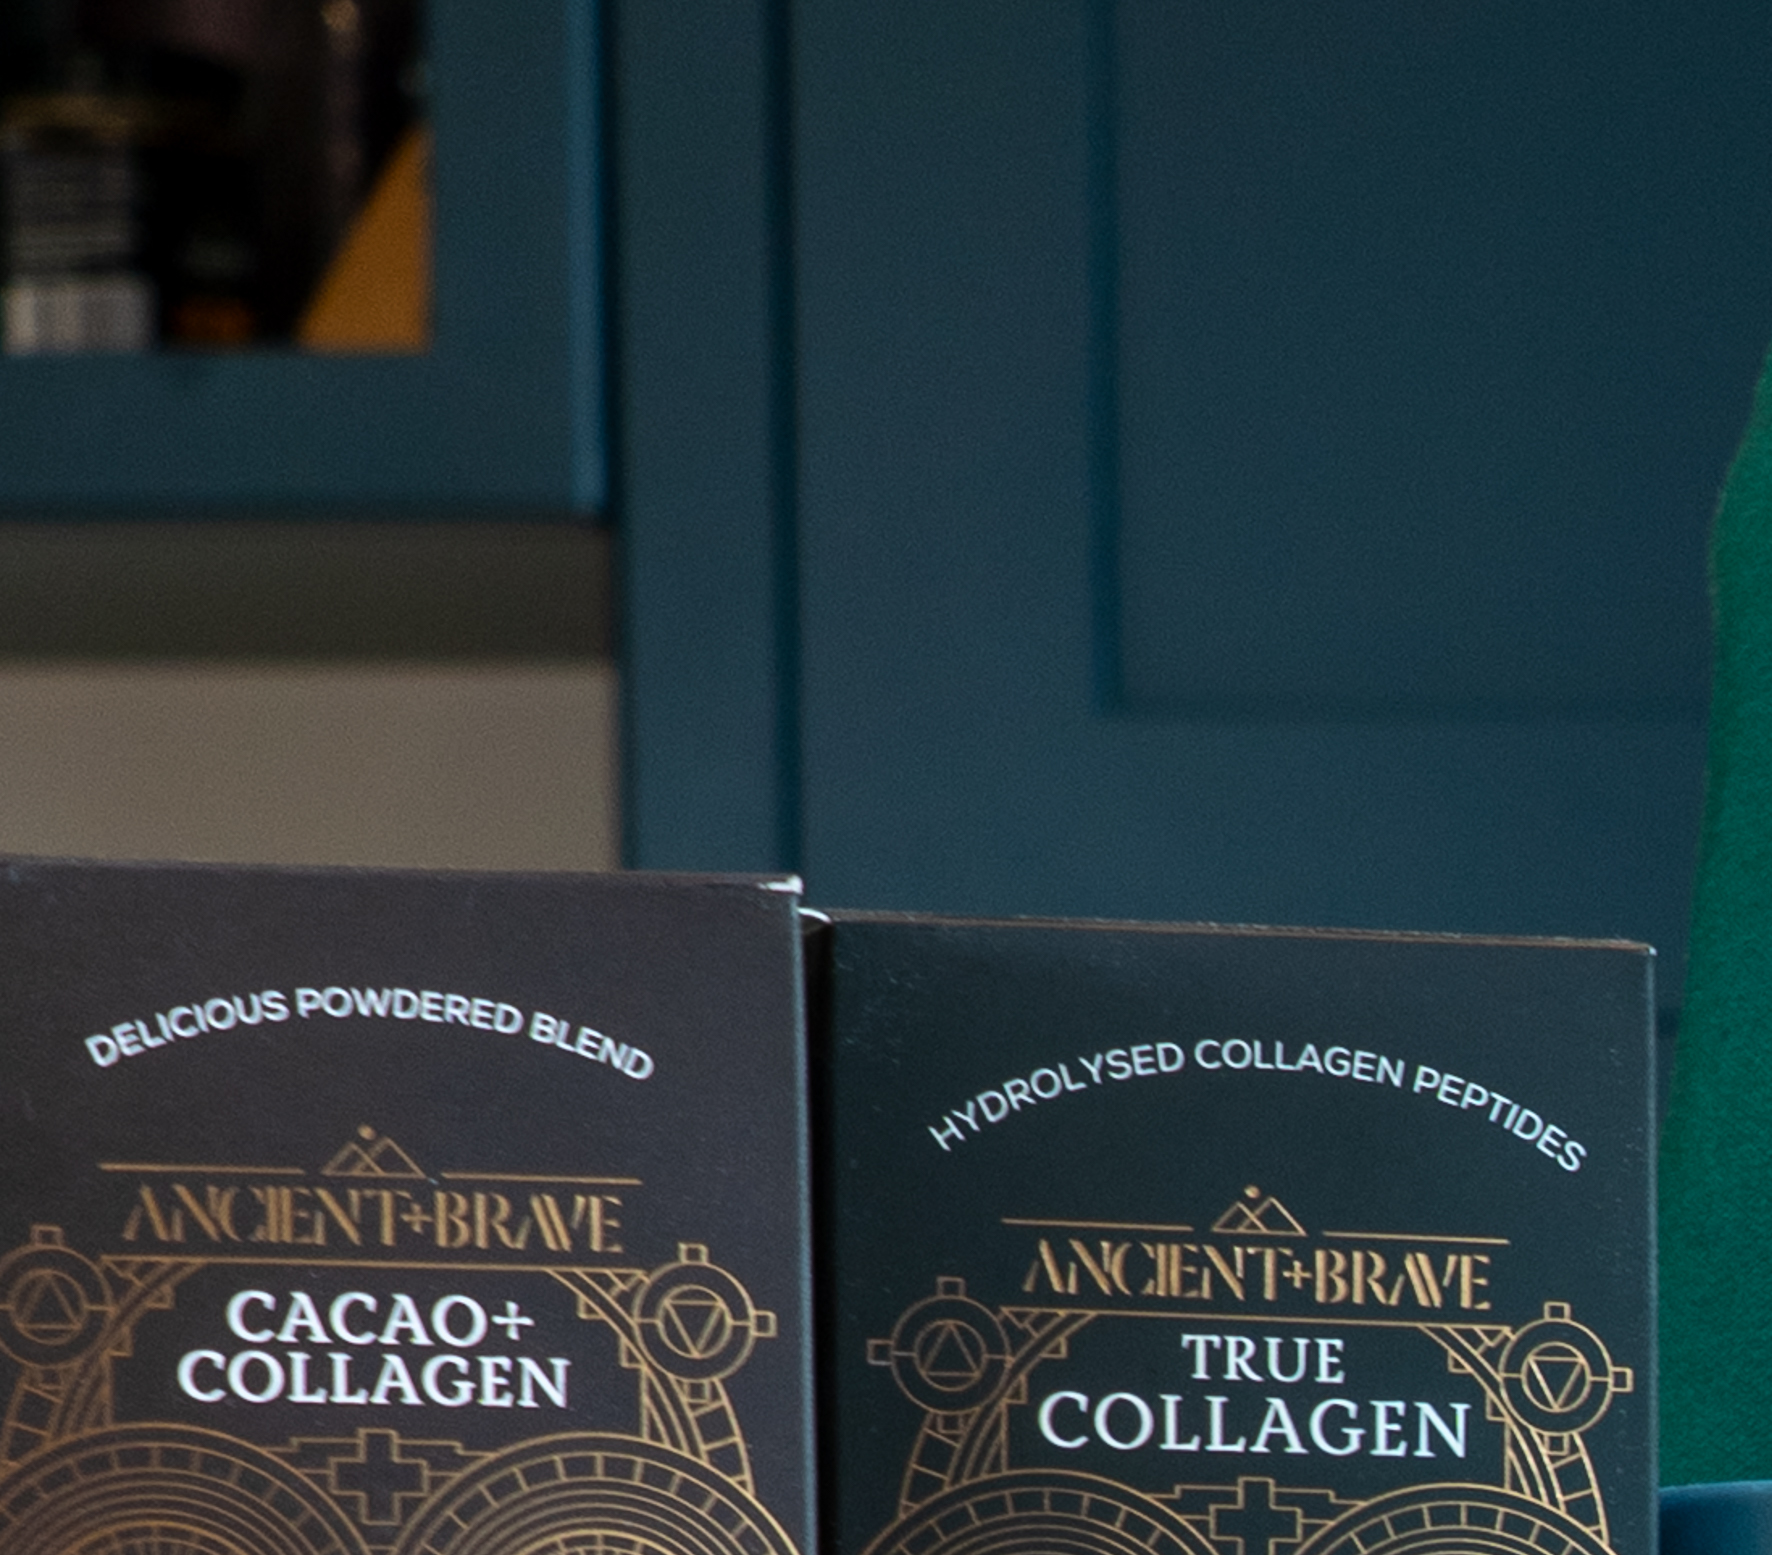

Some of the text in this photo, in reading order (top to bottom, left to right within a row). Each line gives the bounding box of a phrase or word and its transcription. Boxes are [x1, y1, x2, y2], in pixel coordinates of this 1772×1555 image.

[85, 987, 655, 1080] DELICIOUS POWDERED BLEND
[928, 1039, 1588, 1172] HYDROLYSED COLLAGEN PEPTIDES
[226, 1290, 535, 1347] CACAO+
[177, 1350, 571, 1408] COLLAGEN
[1181, 1334, 1345, 1384] TRUE
[1038, 1391, 1472, 1459] COLLAGEN
